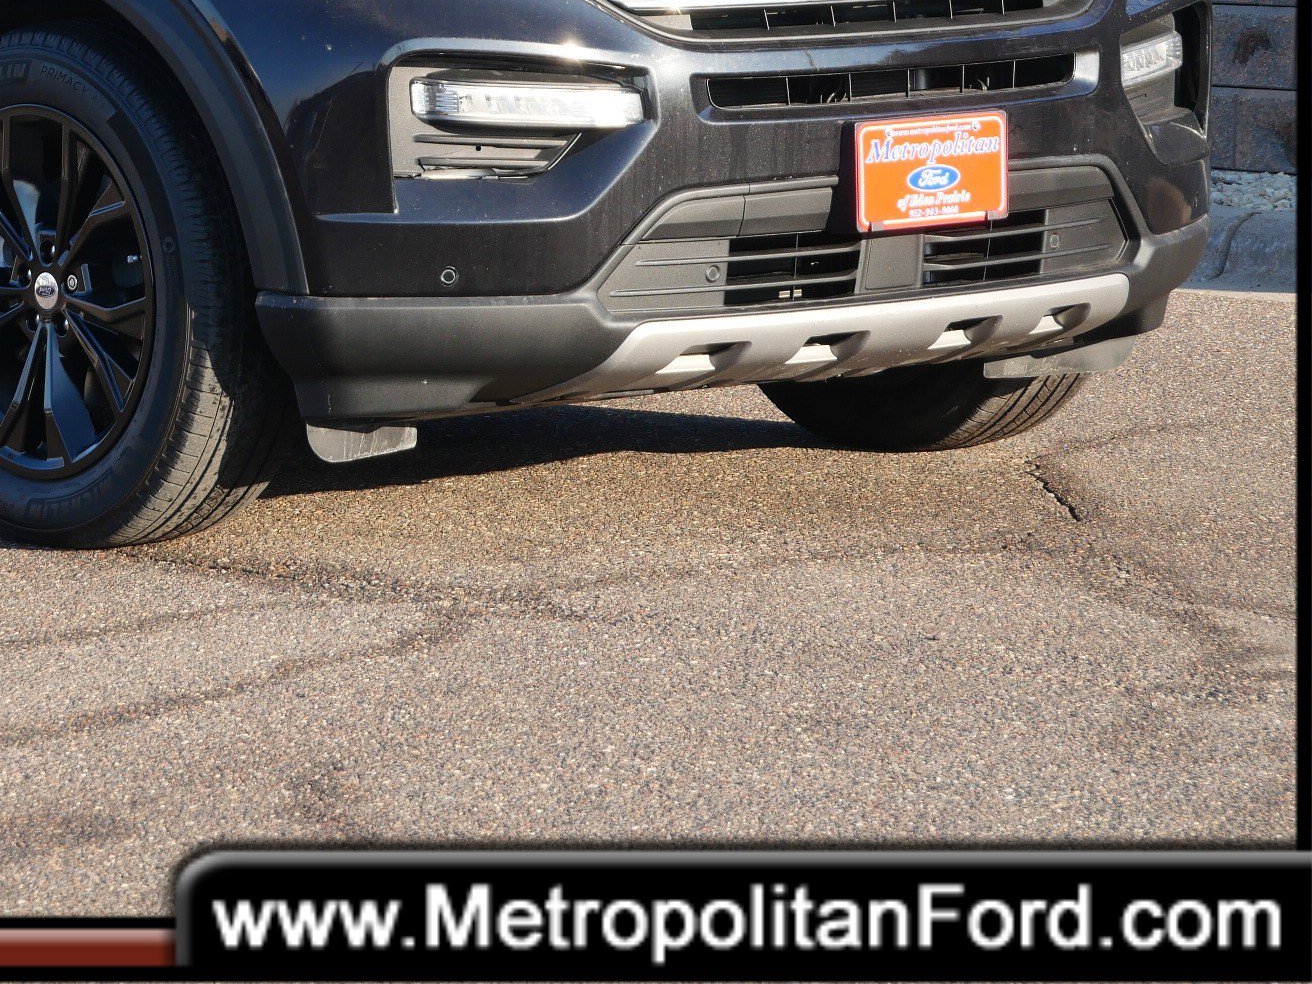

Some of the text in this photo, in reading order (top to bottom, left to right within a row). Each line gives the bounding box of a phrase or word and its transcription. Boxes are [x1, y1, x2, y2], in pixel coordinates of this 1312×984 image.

[40, 65, 89, 94] PRIMACY
[865, 130, 1000, 165] Metropolitan
[918, 169, 950, 186] Ford
[896, 193, 913, 212] of
